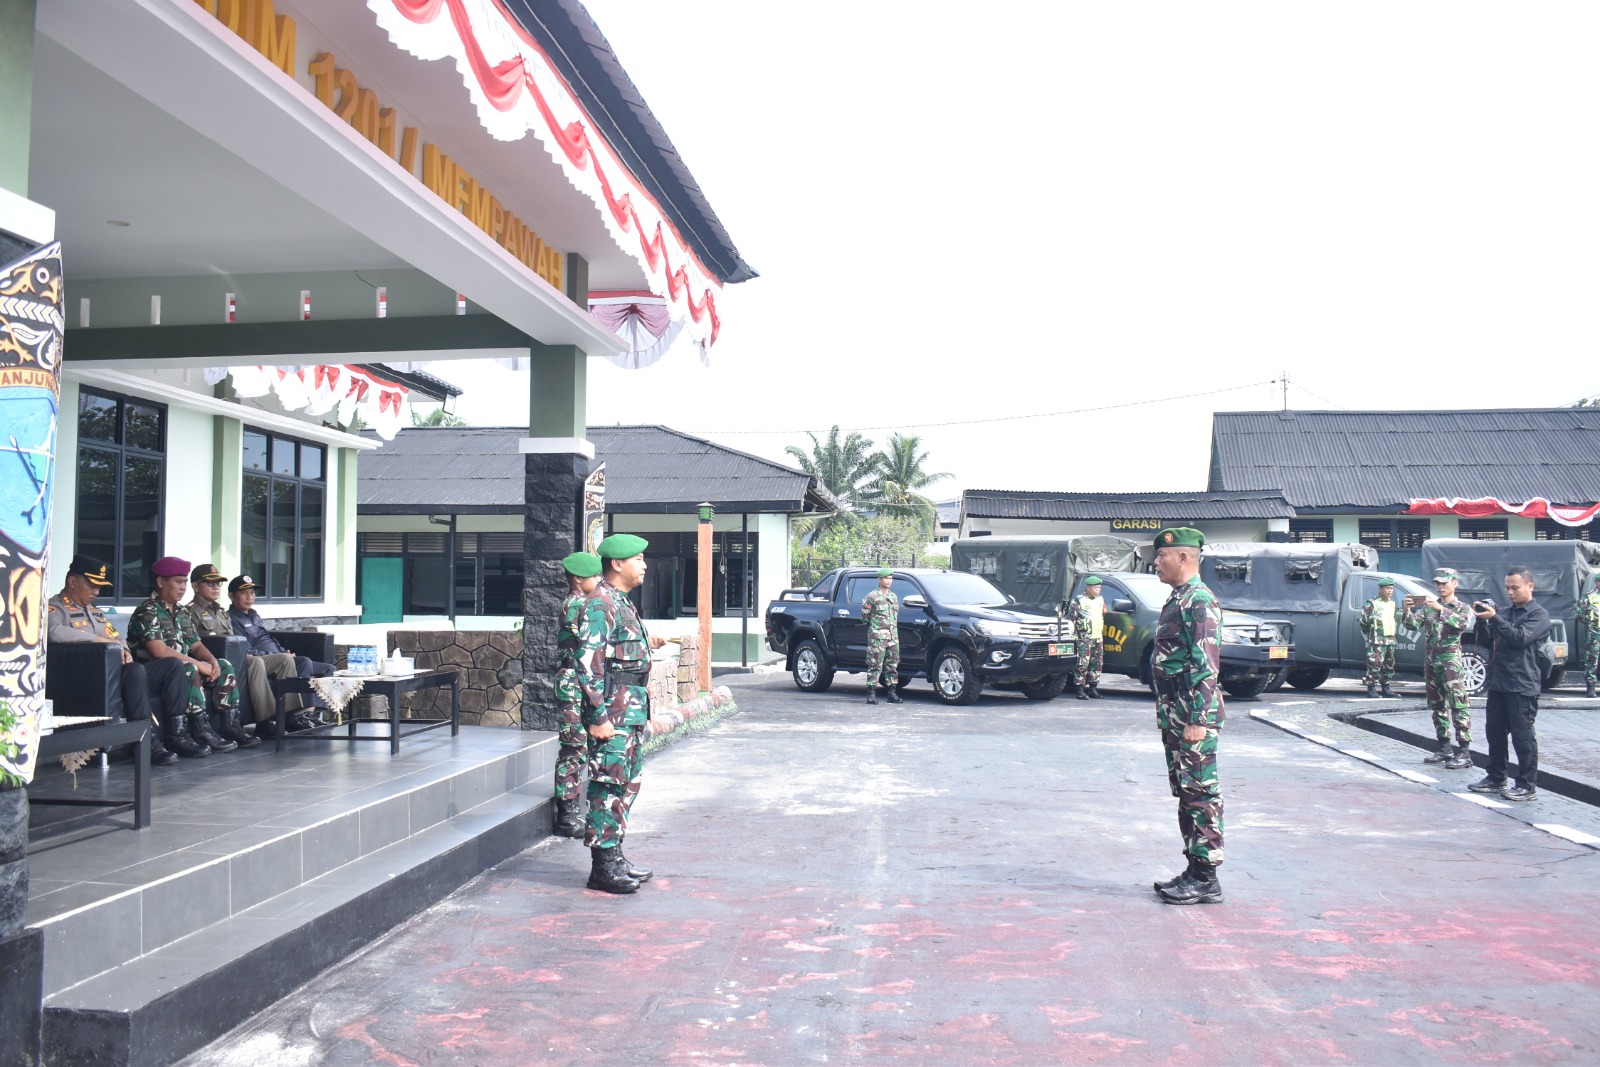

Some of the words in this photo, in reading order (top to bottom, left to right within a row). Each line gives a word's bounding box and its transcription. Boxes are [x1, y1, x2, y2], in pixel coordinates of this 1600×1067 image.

[422, 143, 563, 292] MEMPAWAH
[1112, 518, 1162, 529] GARASI
[1394, 642, 1417, 651] 201-02
